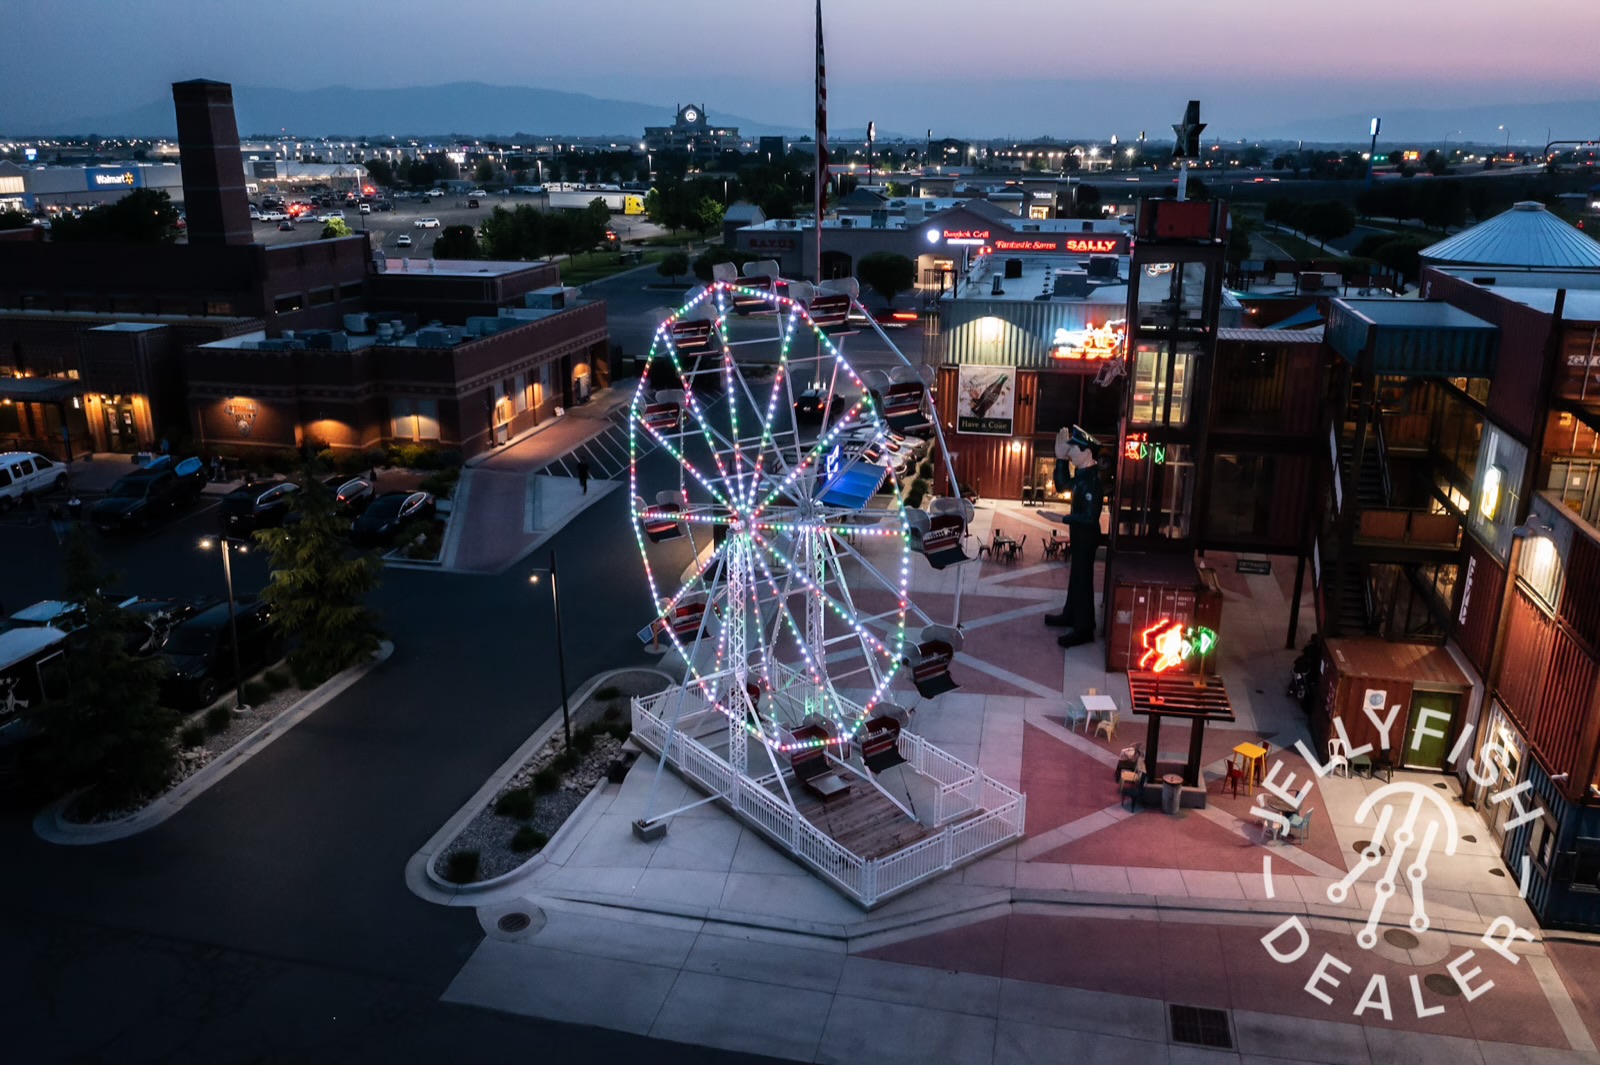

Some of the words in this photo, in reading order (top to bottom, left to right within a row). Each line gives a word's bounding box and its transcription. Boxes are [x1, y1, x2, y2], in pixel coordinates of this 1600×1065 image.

[96, 175, 125, 184] Walmart
[943, 230, 971, 239] Bangkok
[995, 240, 1032, 249] Fantastic
[1032, 241, 1057, 249] Sams
[1066, 240, 1116, 251] SALLY
[961, 420, 980, 428] Have
[988, 421, 1008, 429] Coke
